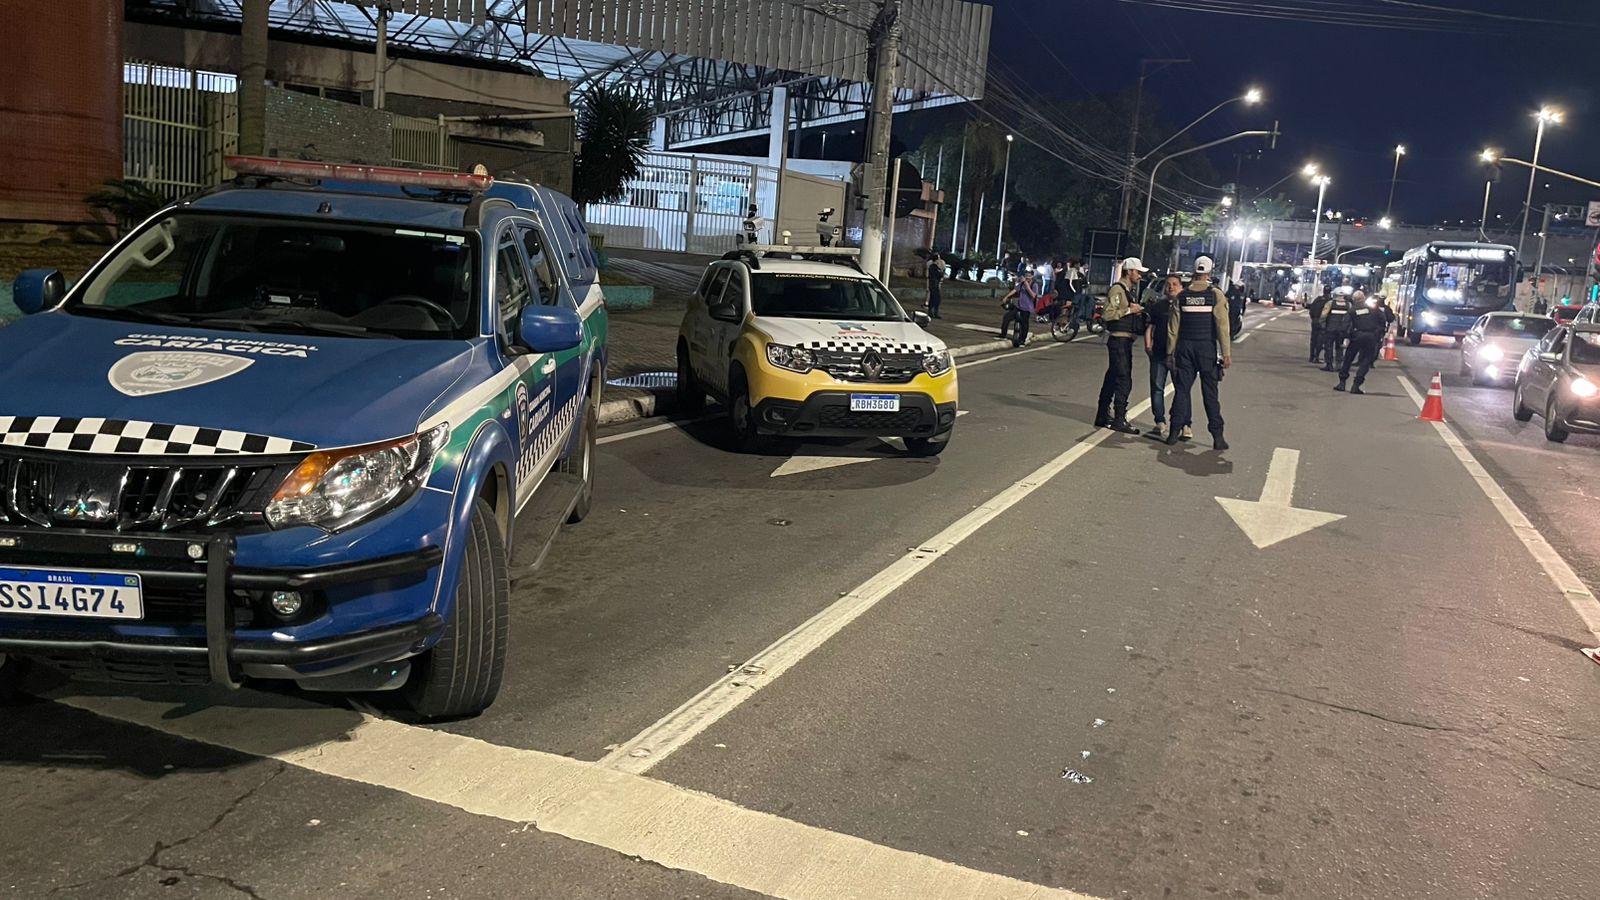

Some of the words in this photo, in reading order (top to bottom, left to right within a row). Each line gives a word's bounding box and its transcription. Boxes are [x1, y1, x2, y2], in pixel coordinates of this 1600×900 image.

[114, 338, 307, 358] CARIACICA
[128, 333, 208, 341] GUARDA
[214, 338, 318, 351] MUNICIPAL
[855, 400, 894, 409] RBH3G80
[48, 575, 73, 583] BRASIL
[0, 583, 125, 613] SSI4G74
